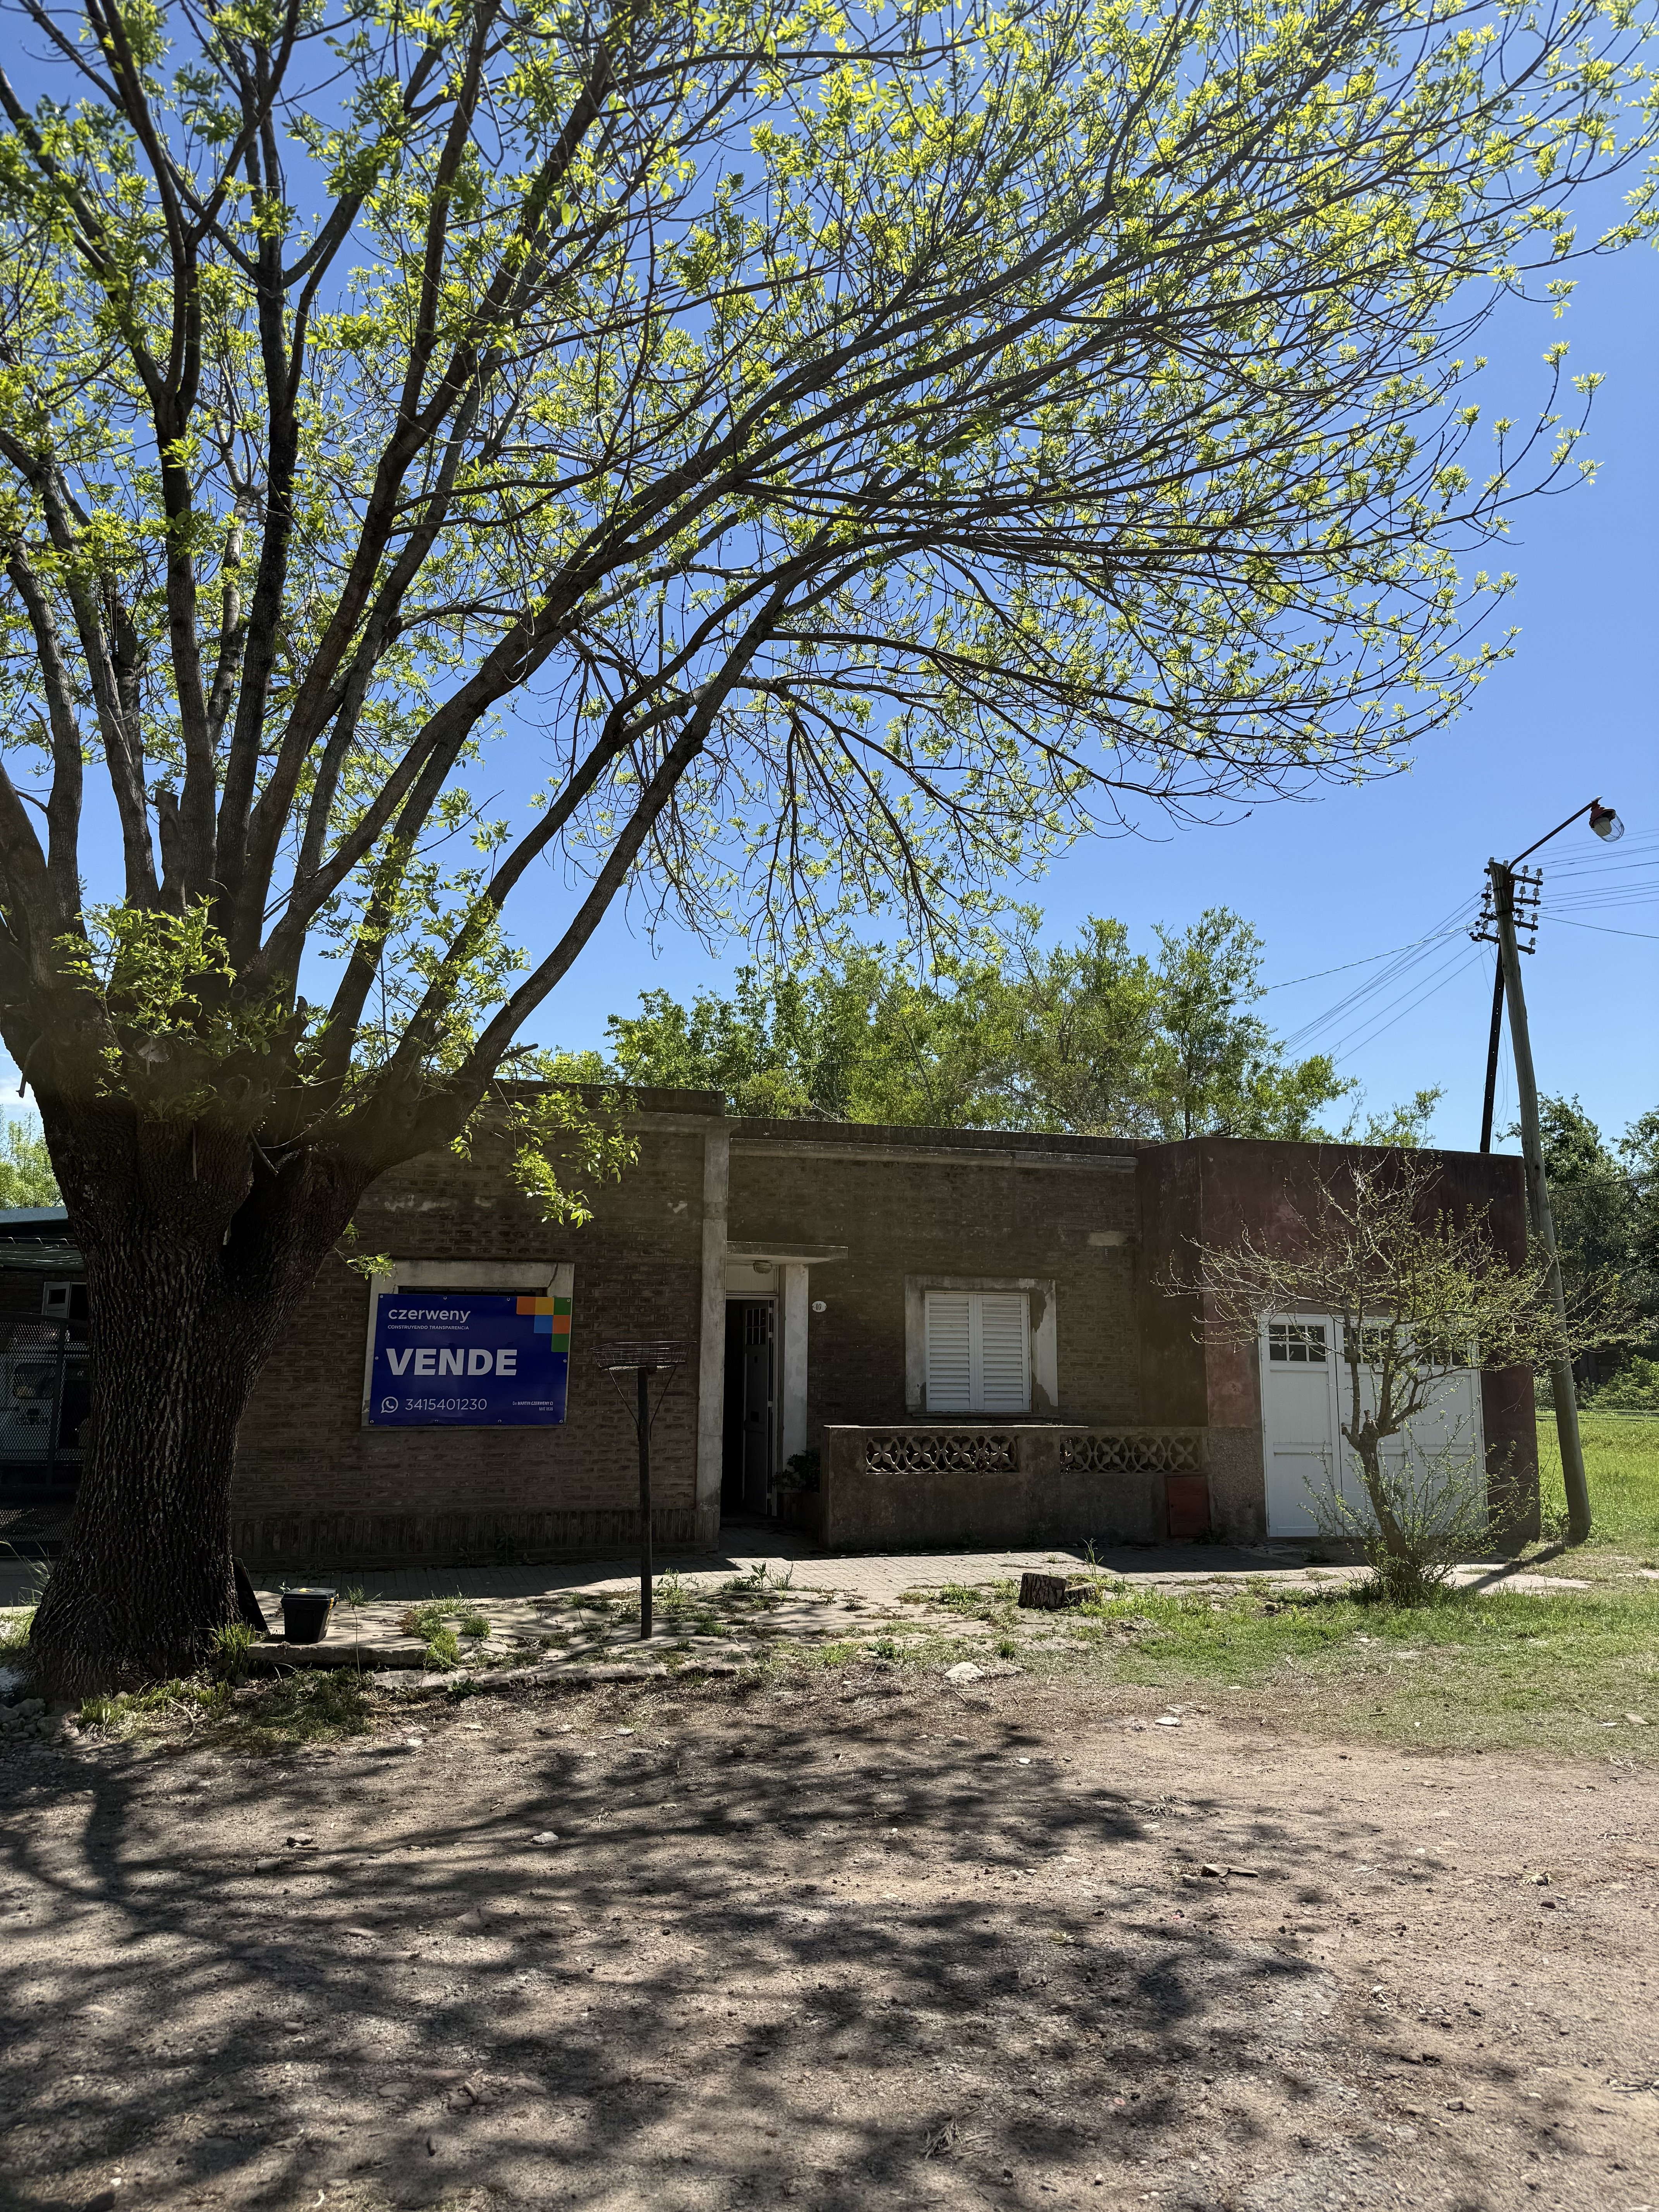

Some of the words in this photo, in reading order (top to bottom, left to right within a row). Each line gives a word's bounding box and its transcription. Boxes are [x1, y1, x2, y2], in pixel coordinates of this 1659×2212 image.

[388, 1309, 471, 1323] czerweny
[386, 1348, 517, 1376] VENDE
[405, 1398, 487, 1410] 3415401230
